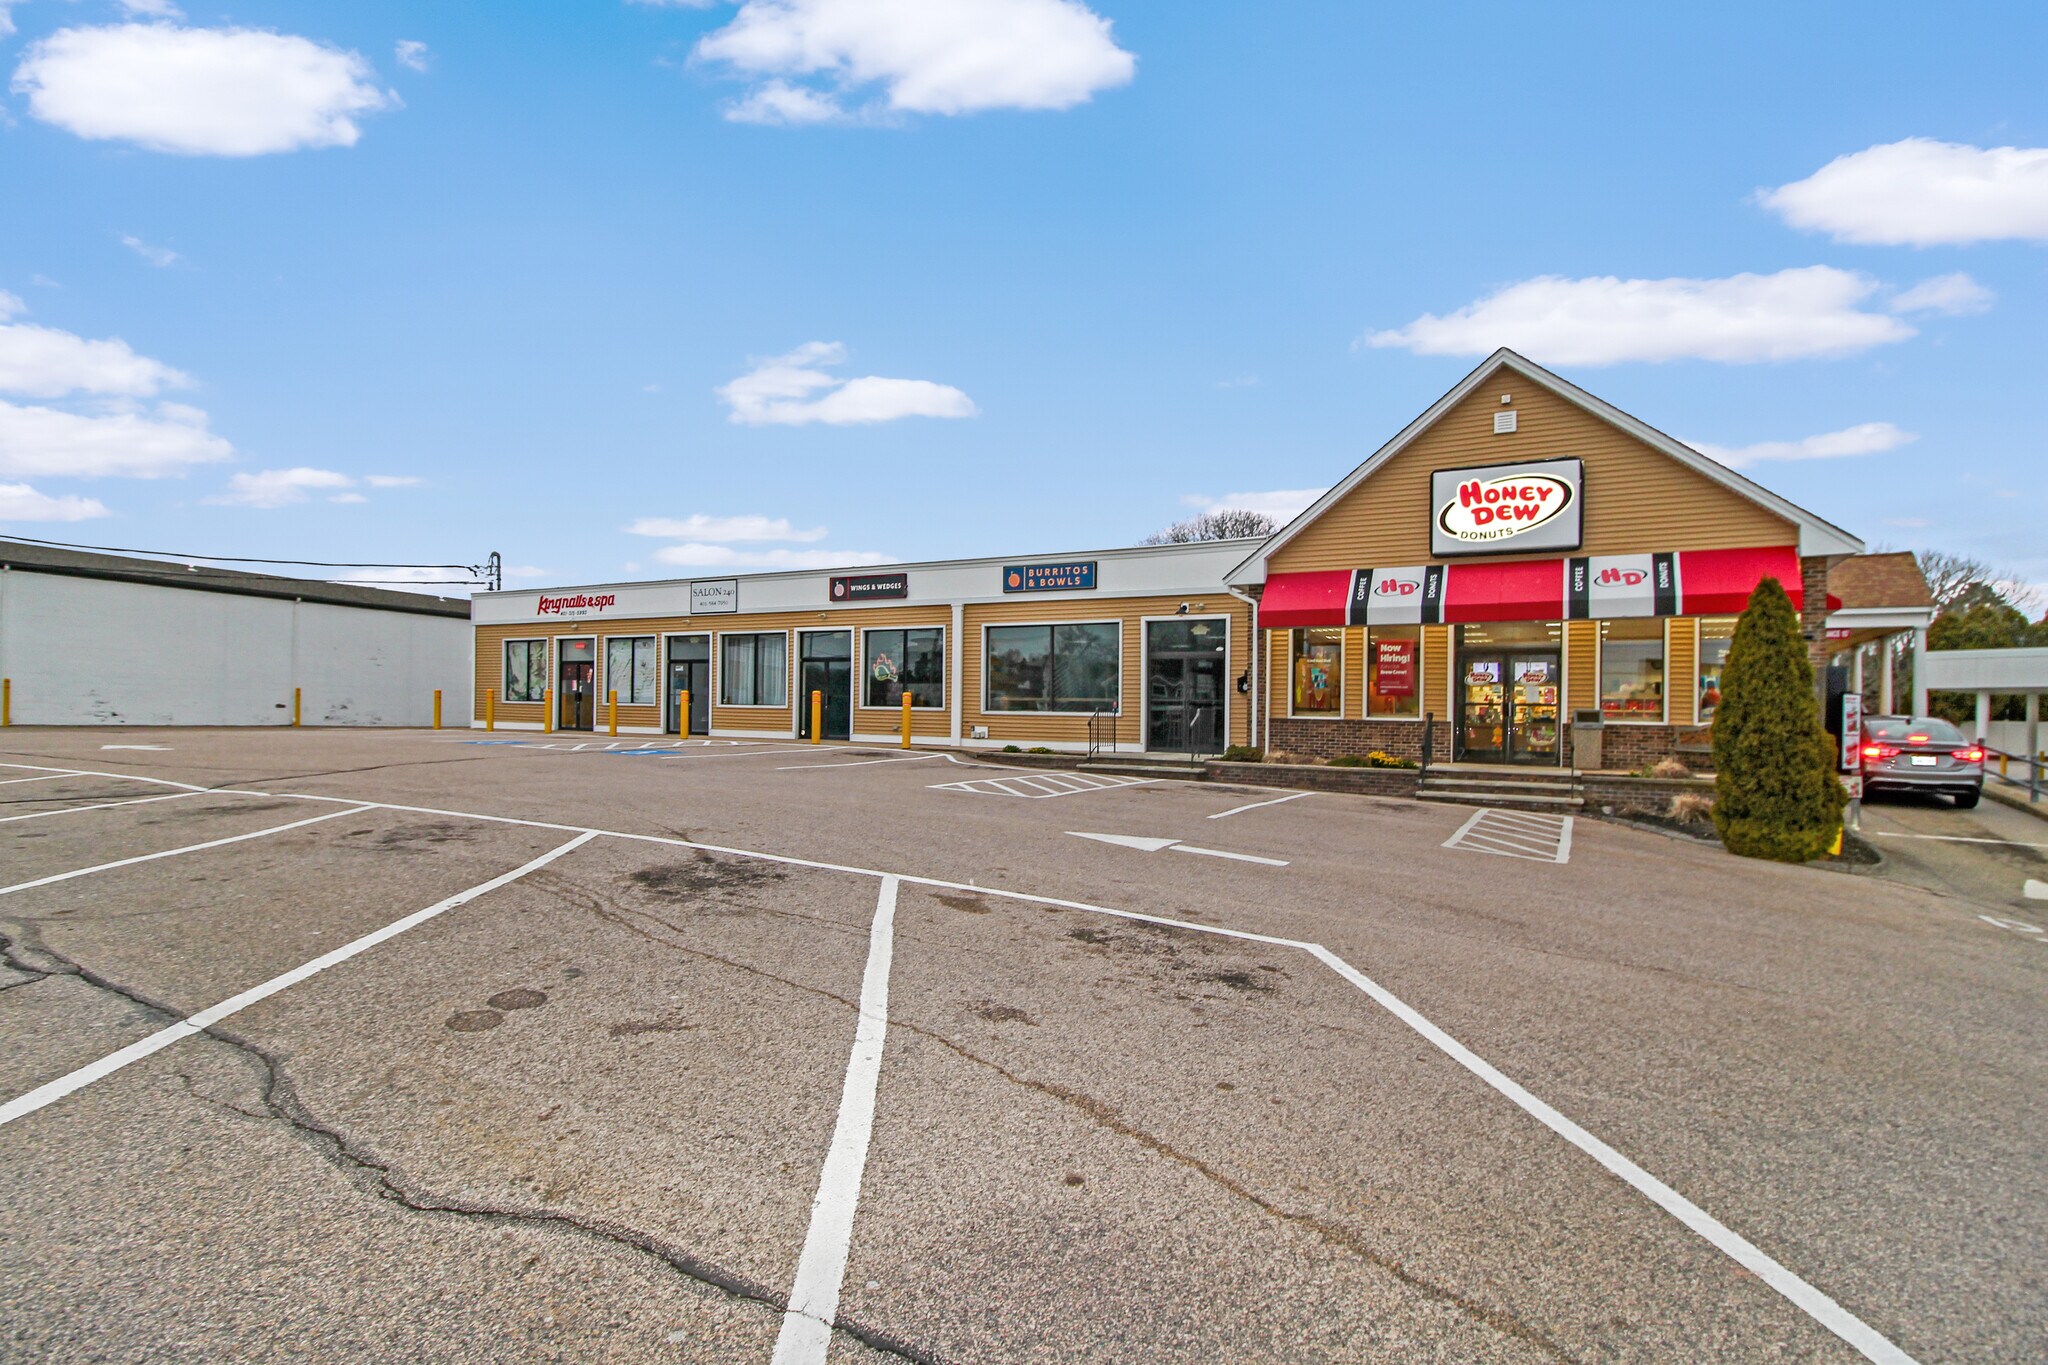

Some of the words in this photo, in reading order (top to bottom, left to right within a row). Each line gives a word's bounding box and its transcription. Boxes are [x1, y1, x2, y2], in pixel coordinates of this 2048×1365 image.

[1459, 481, 1553, 508] HONEY
[1471, 504, 1540, 526] DEW
[1460, 527, 1514, 540] DONUTS
[1028, 566, 1089, 577] BURRITOS
[1659, 562, 1669, 588] DONUTS
[1028, 579, 1035, 587] &
[1040, 577, 1081, 587] BOWLS
[1427, 573, 1438, 598] DONUTS
[1574, 566, 1584, 592] COFFEE
[692, 587, 722, 597] SALON
[877, 582, 902, 590] WEDGES
[1356, 577, 1368, 600] COFFEE
[1380, 644, 1402, 652] Now
[1380, 653, 1410, 664] Hiring!
